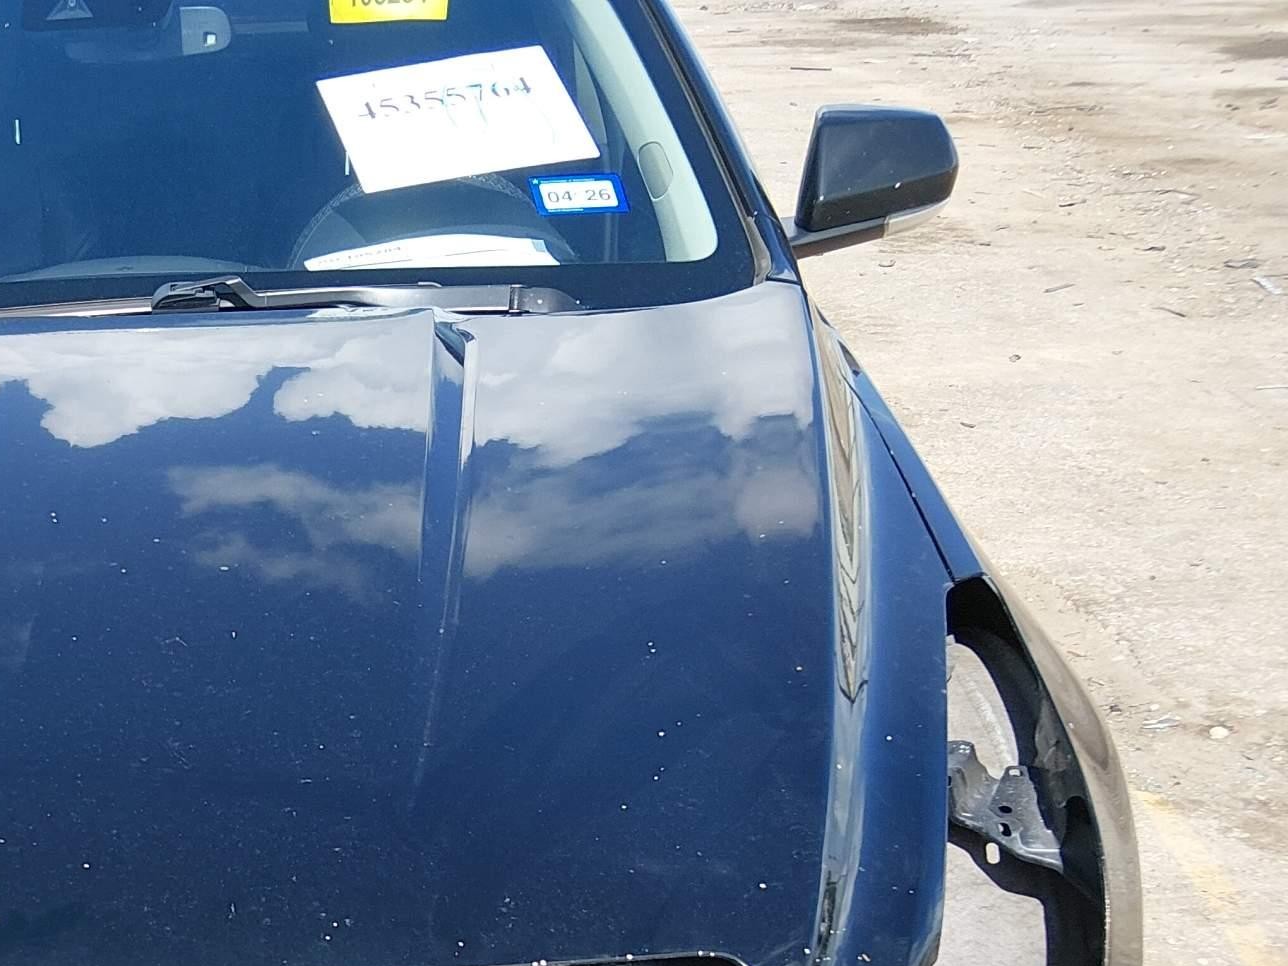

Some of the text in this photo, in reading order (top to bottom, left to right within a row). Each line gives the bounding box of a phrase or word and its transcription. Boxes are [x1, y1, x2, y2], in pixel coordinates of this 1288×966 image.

[357, 76, 532, 119] 45355764
[547, 188, 611, 203] 04 26
